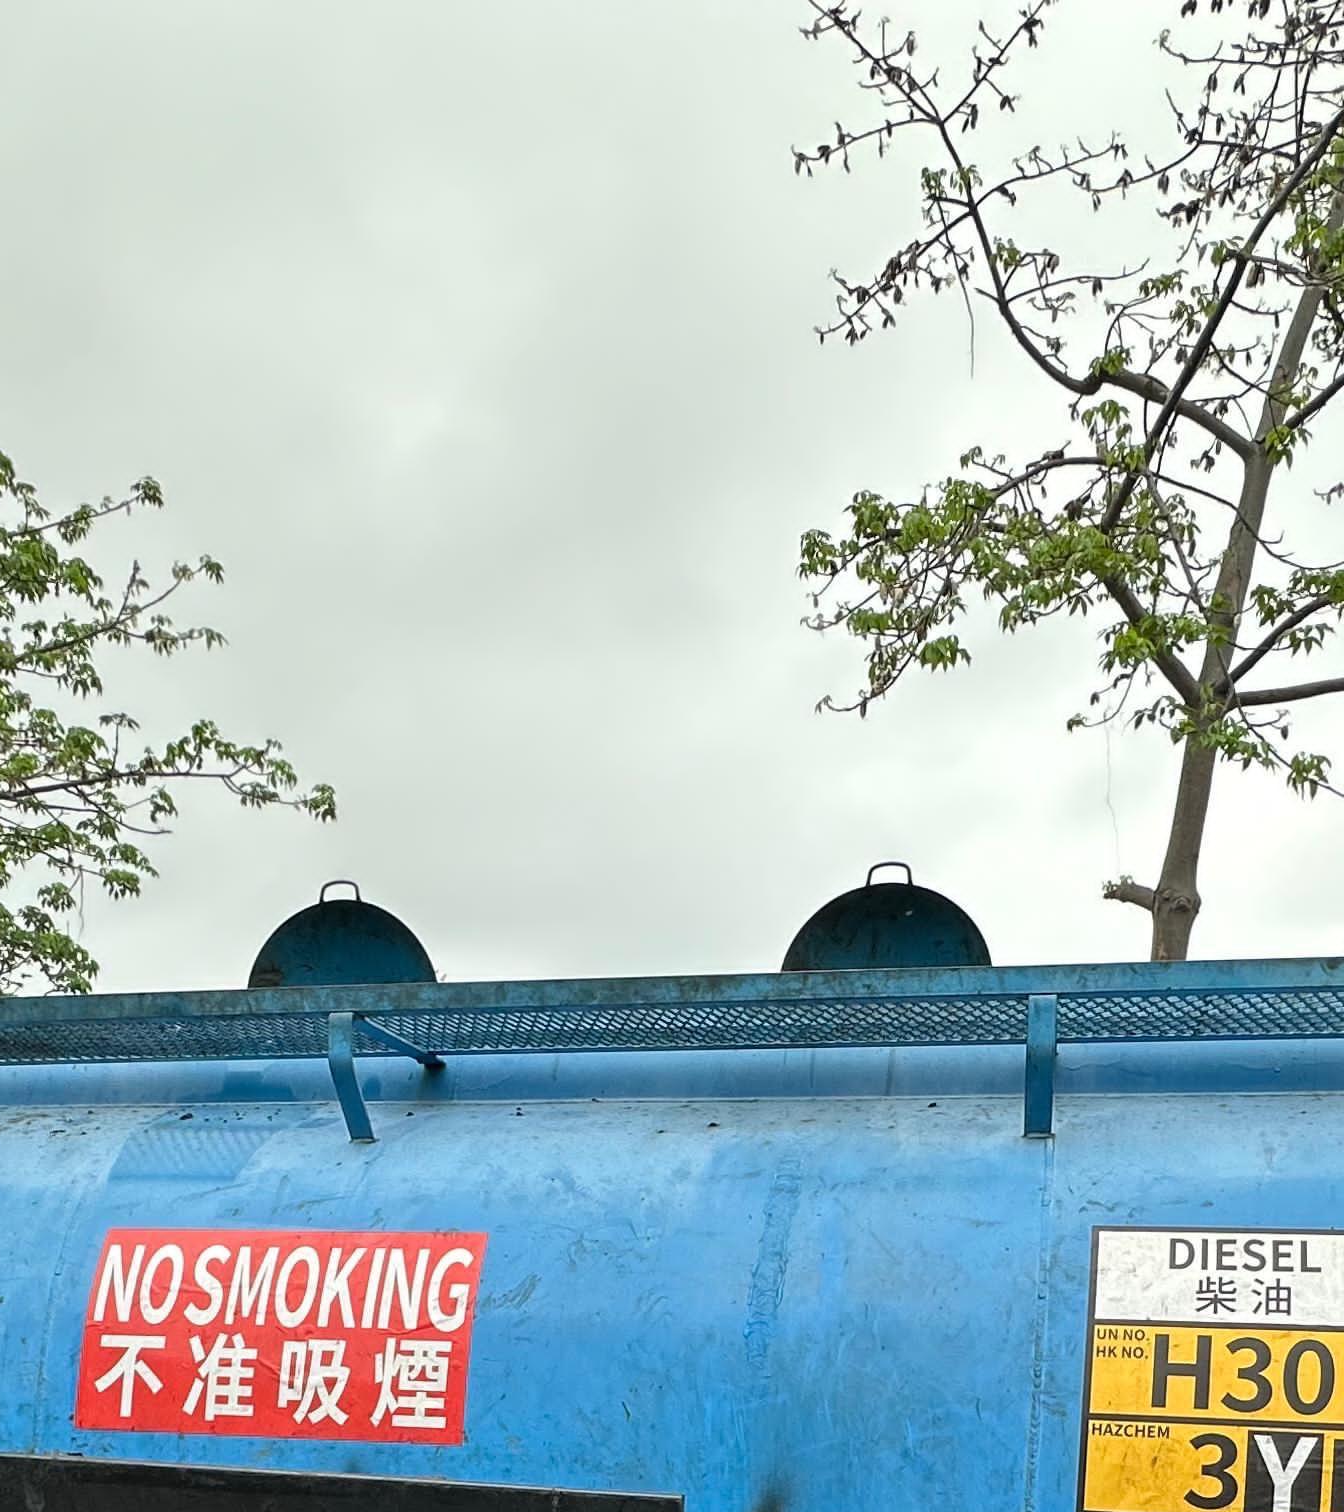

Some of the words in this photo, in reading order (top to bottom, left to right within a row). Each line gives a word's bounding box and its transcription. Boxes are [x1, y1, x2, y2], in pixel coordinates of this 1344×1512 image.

[1168, 1238, 1322, 1273] DIESEL
[1195, 1276, 1292, 1316] 柴油
[1096, 1329, 1118, 1341] UN
[1123, 1330, 1150, 1342] NO.
[1096, 1346, 1117, 1357] HK
[1121, 1347, 1149, 1359] NO.
[94, 1333, 453, 1429] 不准吸煙
[1091, 1423, 1170, 1439] HAZCHEM
